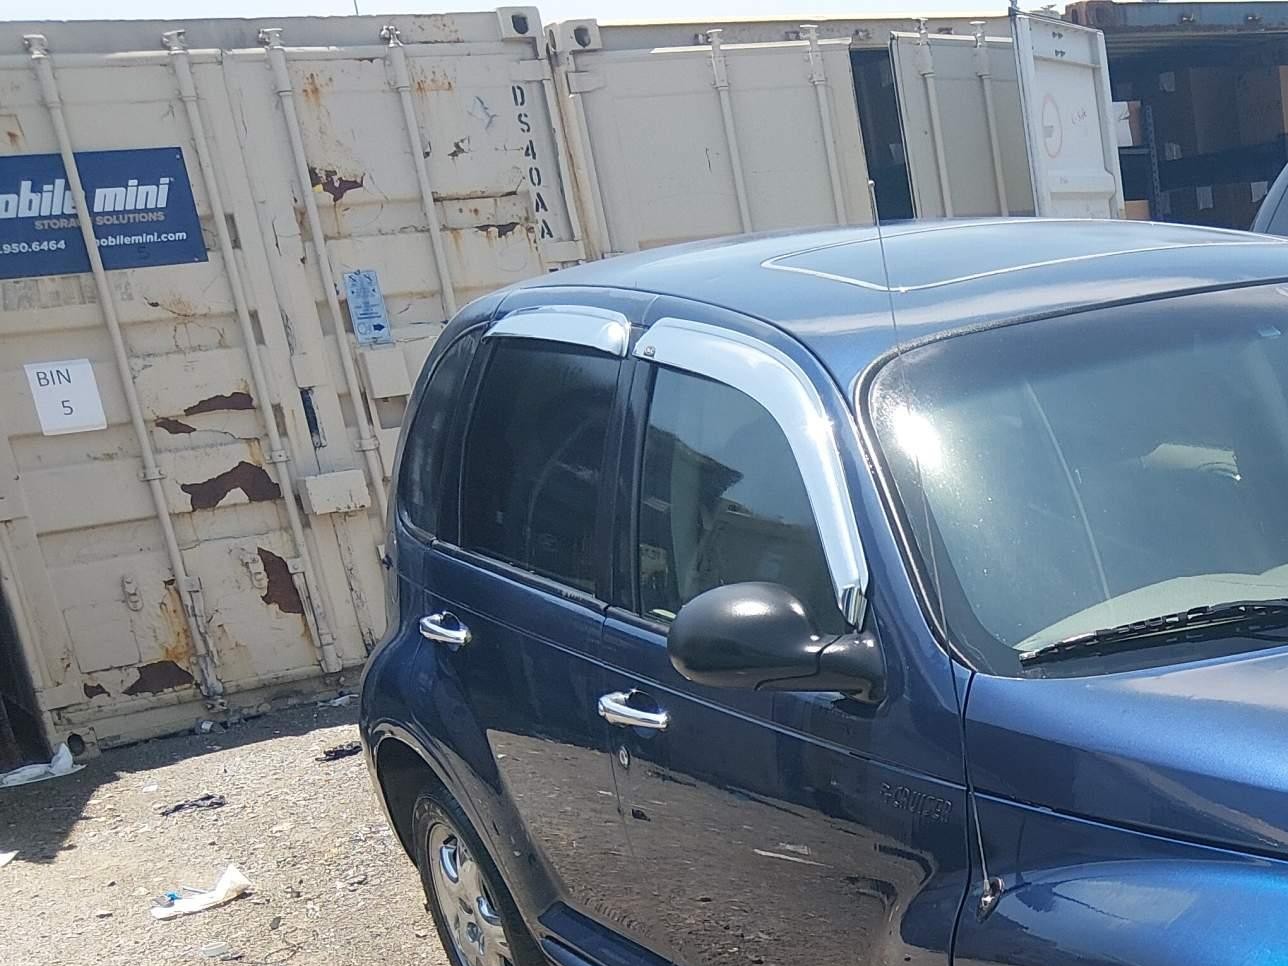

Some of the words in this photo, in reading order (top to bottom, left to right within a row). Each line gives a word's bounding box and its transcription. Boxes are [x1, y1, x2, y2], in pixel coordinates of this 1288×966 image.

[93, 177, 170, 213] mini
[95, 211, 166, 226] SOLUTIONS
[35, 367, 72, 388] BIN
[61, 399, 74, 416] 5
